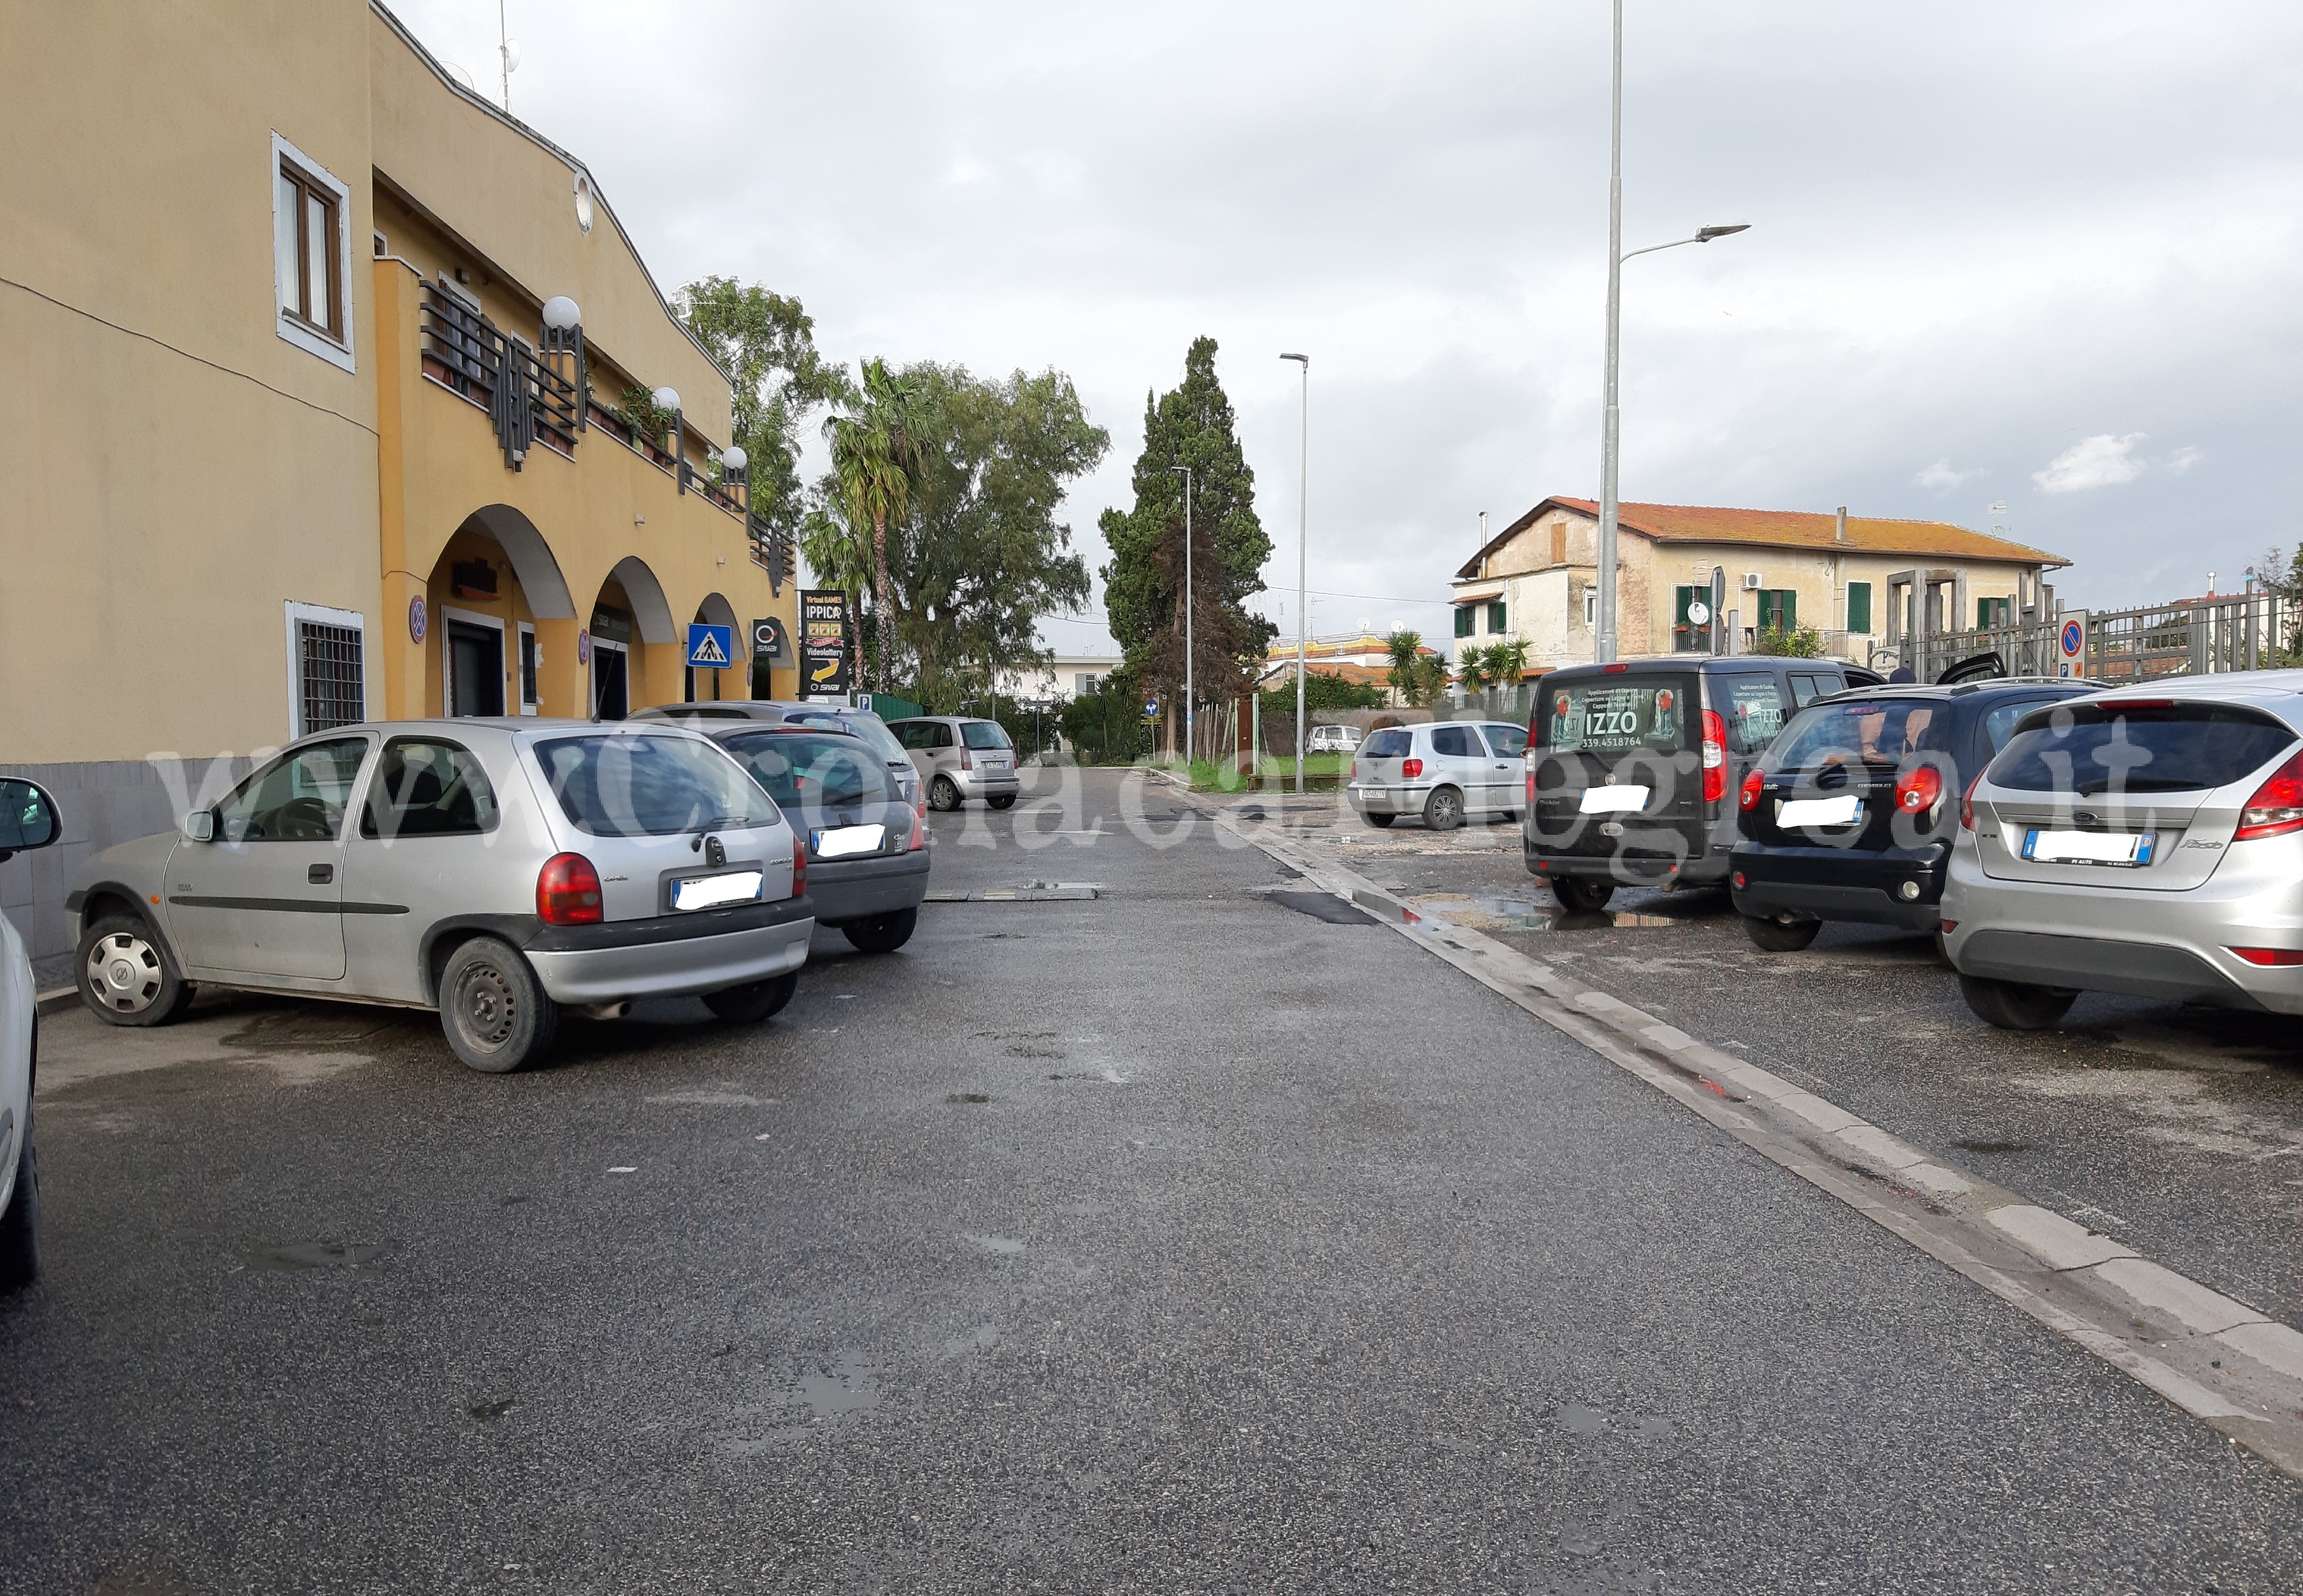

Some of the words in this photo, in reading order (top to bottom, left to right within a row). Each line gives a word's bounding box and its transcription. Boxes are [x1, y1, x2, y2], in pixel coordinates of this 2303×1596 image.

[806, 605, 841, 619] IPPICA
[807, 648, 843, 658] Videolottery
[2061, 664, 2067, 676] P
[863, 697, 868, 709] P
[1586, 711, 1637, 735] IZZO
[1582, 737, 1641, 748] 339.4518764
